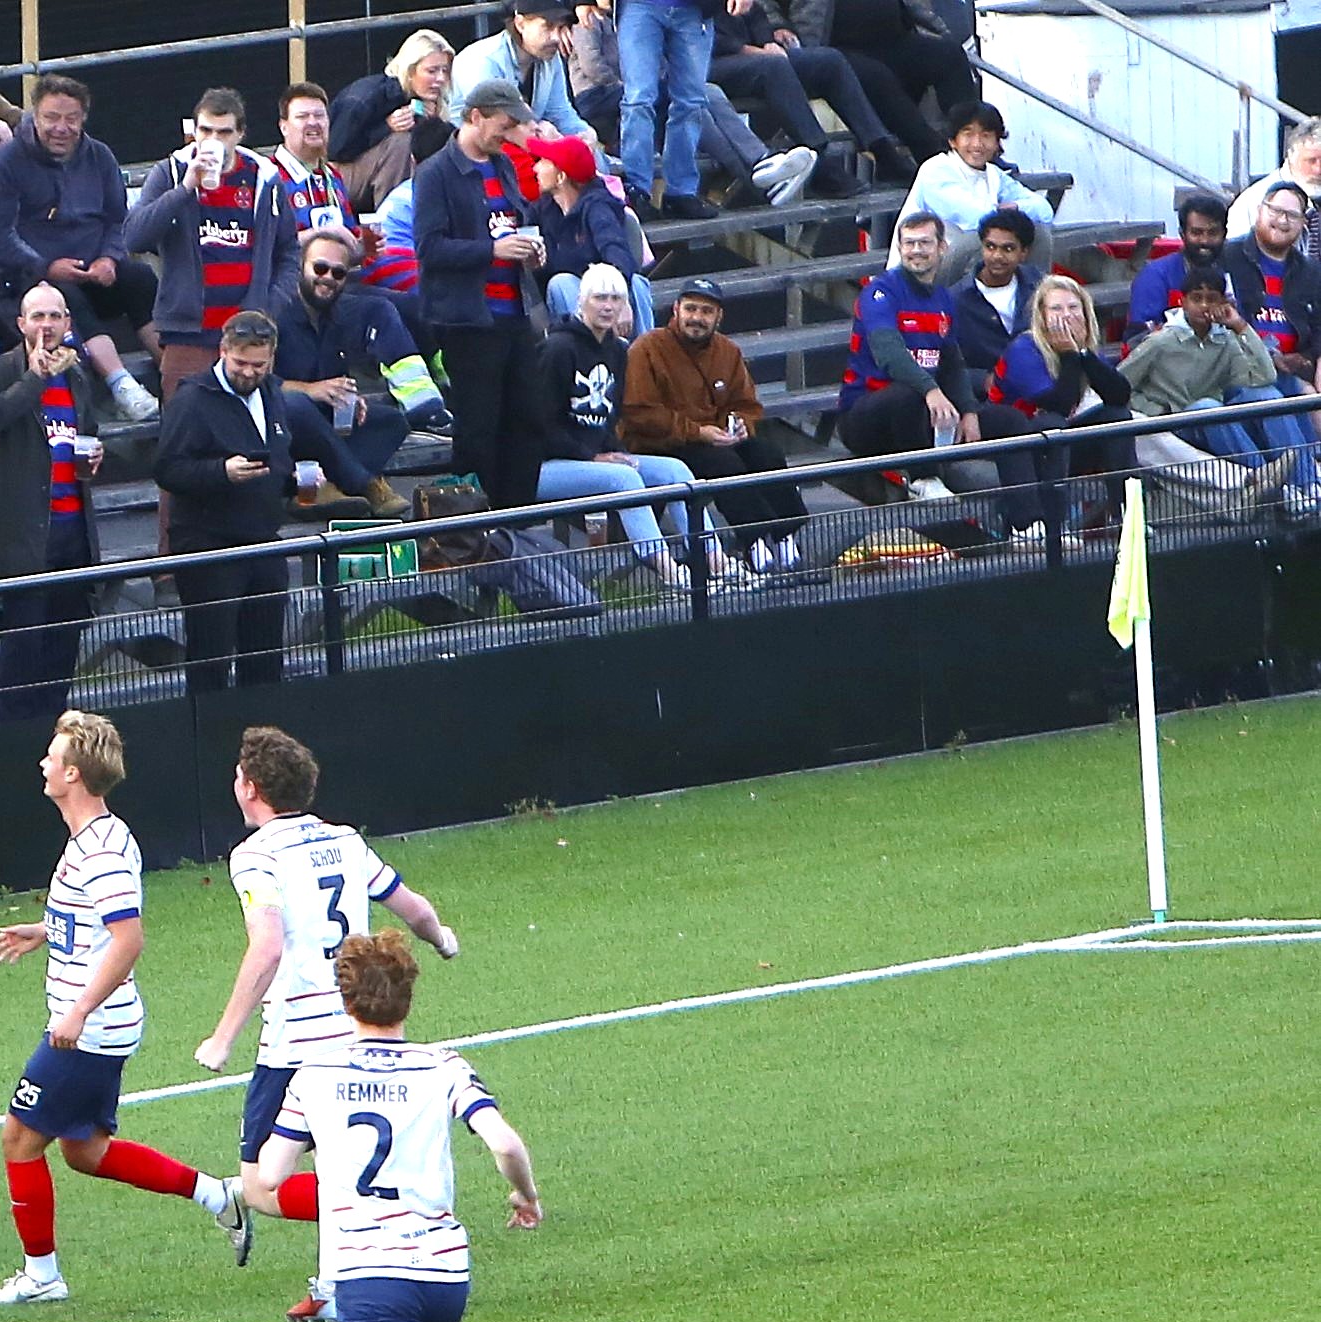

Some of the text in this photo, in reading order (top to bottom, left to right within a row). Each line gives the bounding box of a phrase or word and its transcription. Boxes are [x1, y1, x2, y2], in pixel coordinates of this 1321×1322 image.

[199, 219, 248, 247] rlsberg
[317, 873, 349, 960] 3
[16, 1078, 41, 1106] 25
[336, 1082, 408, 1102] REMMER
[347, 1111, 400, 1200] 2
